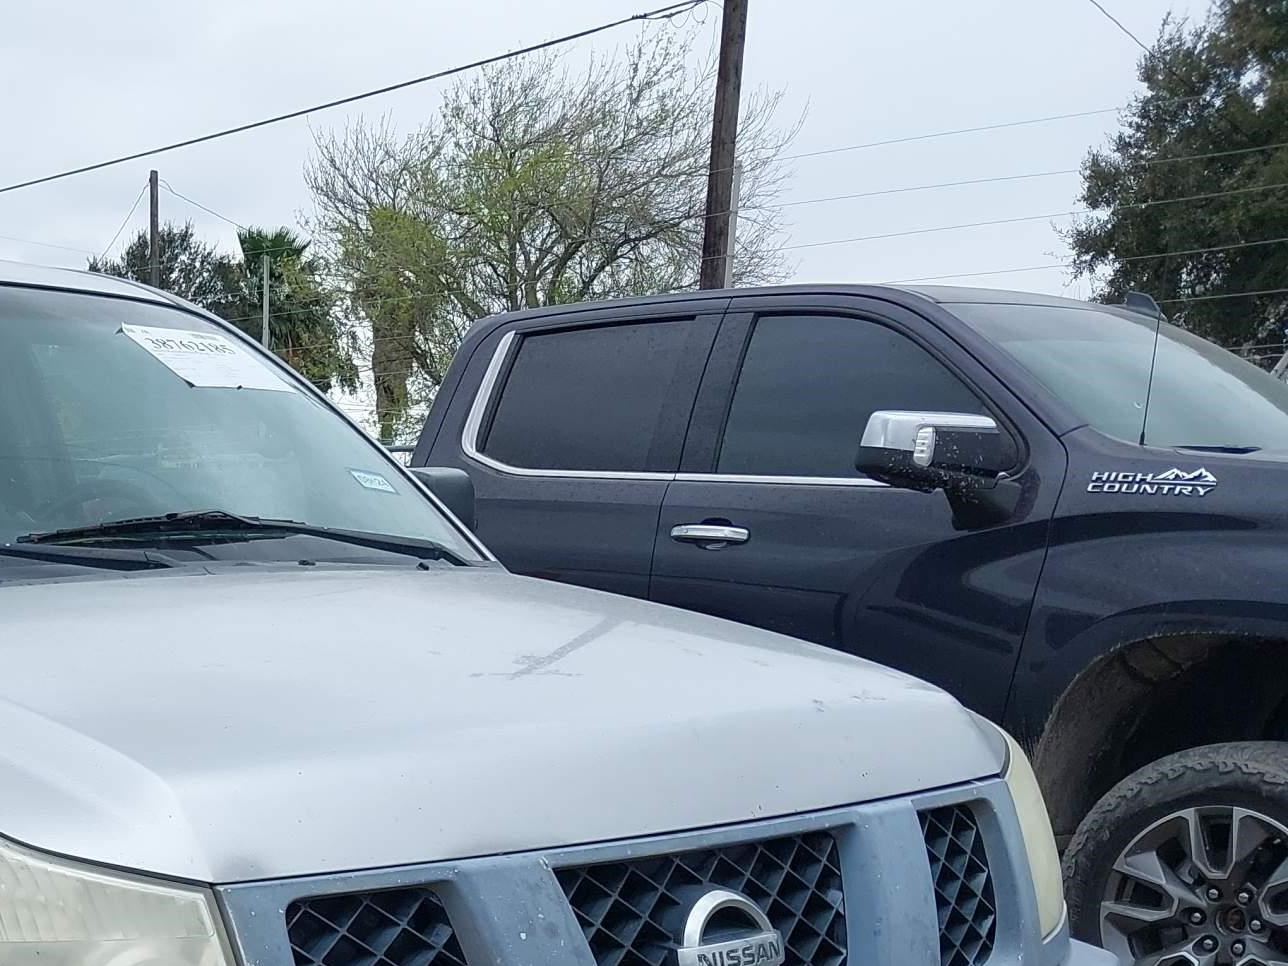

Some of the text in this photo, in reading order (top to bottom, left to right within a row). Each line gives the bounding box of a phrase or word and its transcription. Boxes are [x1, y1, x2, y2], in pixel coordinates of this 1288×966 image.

[144, 337, 236, 355] 38762185
[1091, 471, 1154, 483] HIGH
[1087, 482, 1214, 497] COUNTRY
